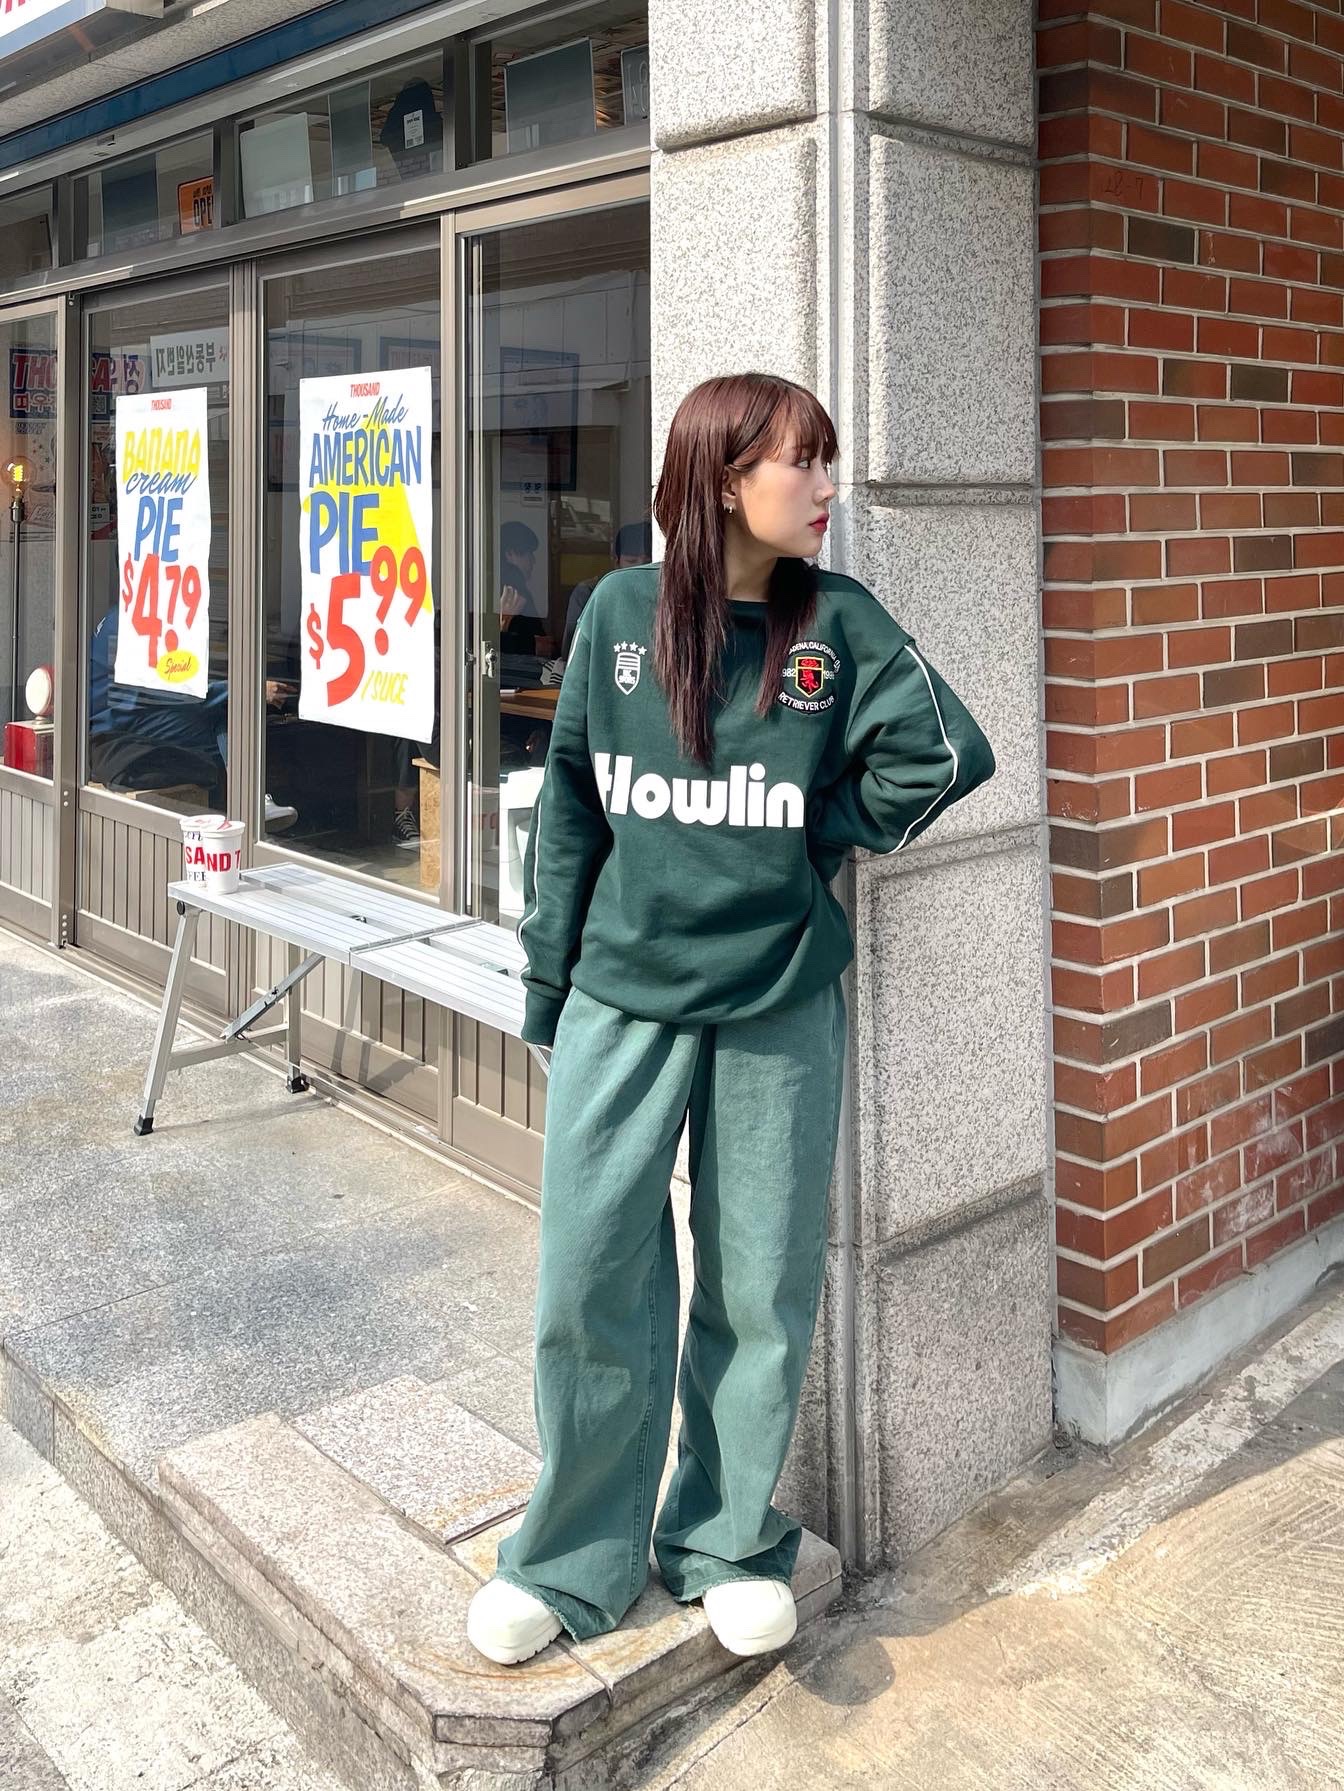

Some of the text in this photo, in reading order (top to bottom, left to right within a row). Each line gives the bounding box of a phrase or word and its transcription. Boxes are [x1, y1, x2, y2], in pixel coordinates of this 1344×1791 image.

[193, 195, 214, 227] OPE
[350, 382, 380, 398] THOUSAND
[309, 426, 421, 488] AMERICAN
[126, 471, 197, 495] cream
[134, 495, 184, 562] PIE
[309, 491, 380, 577] PIE
[164, 657, 193, 680] Special
[782, 668, 797, 677] 982
[777, 691, 820, 712] RETRIEVER
[594, 752, 805, 828] Howlin
